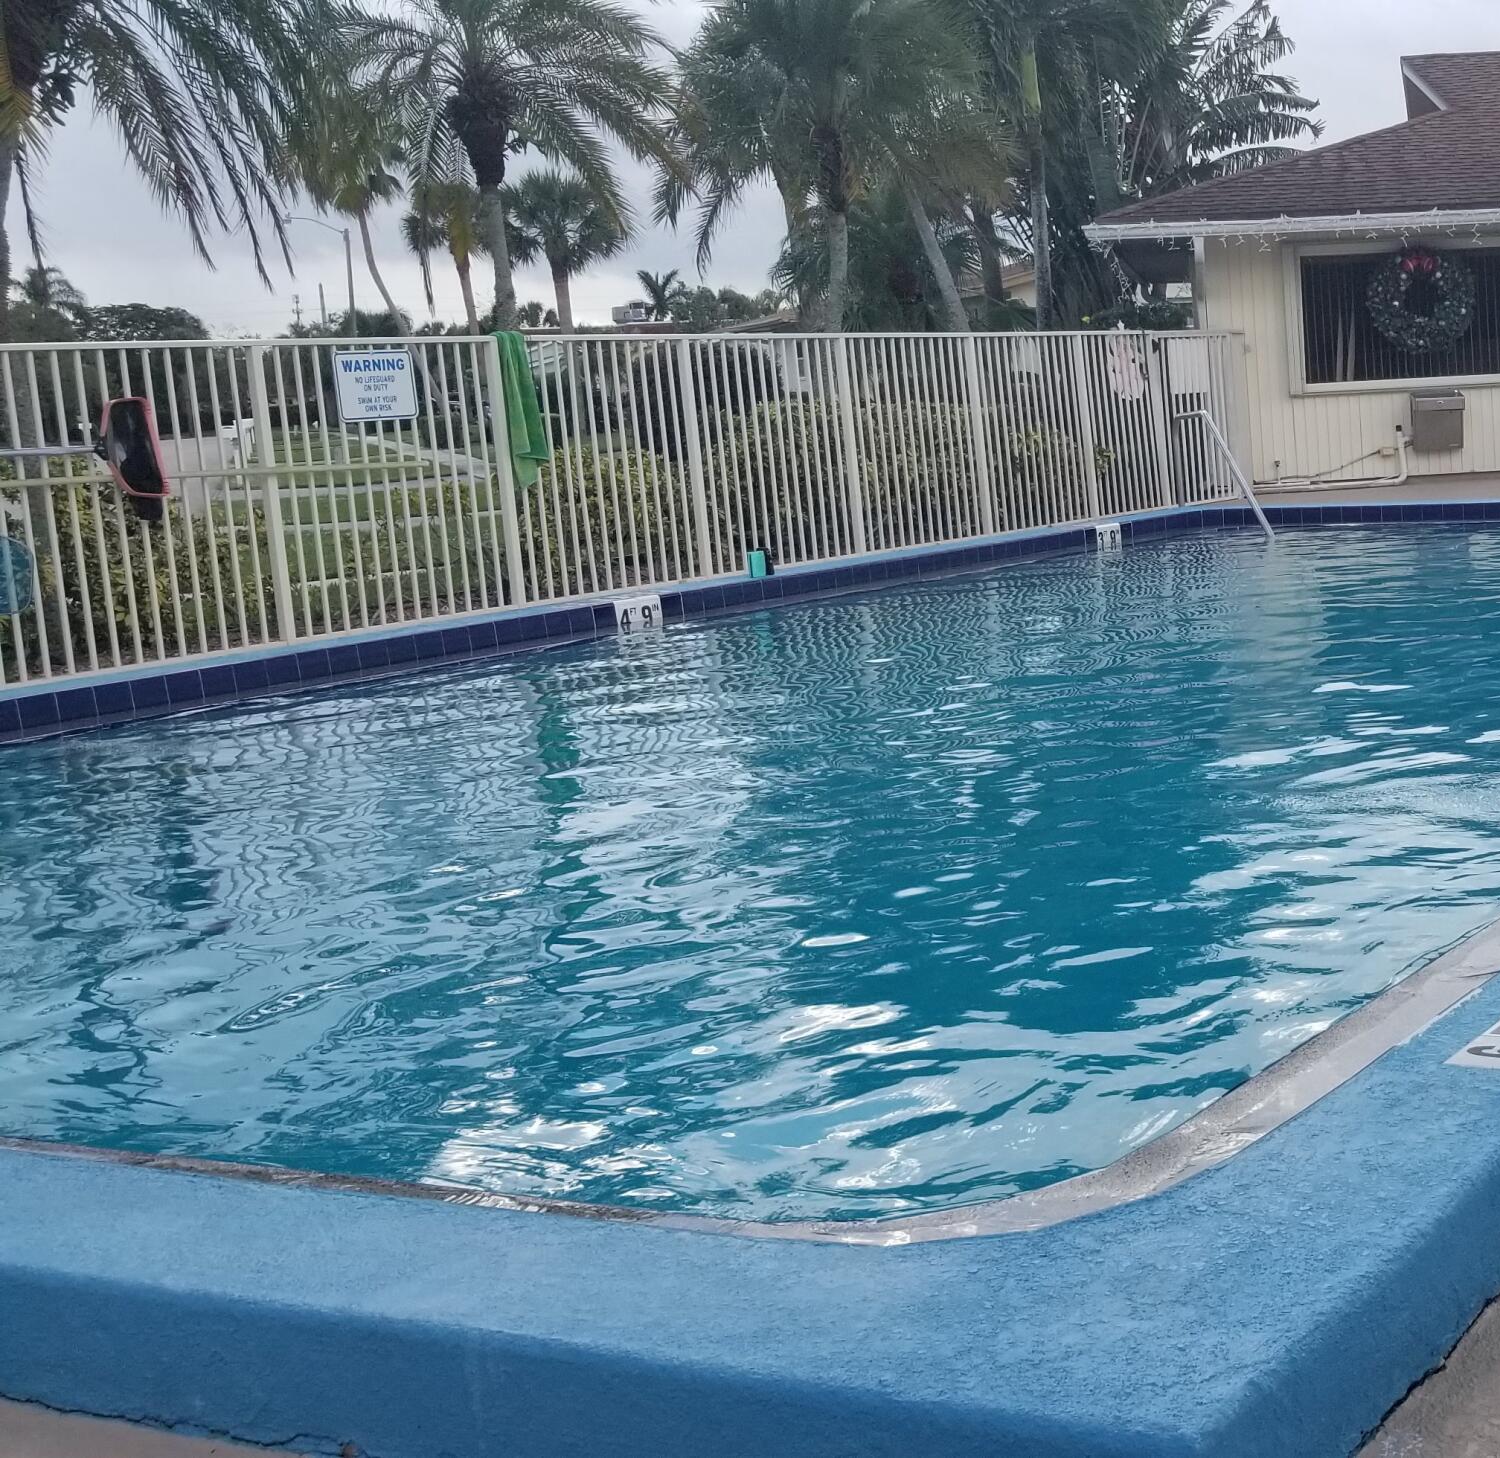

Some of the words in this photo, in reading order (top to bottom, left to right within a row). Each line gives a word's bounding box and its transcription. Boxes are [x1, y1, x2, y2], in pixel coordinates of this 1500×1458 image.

[341, 359, 405, 372] WARNING
[364, 375, 395, 383] LIFEGUARD
[621, 609, 632, 624] 4
[630, 607, 636, 615] FT
[641, 605, 653, 621] 9
[652, 604, 659, 612] IN
